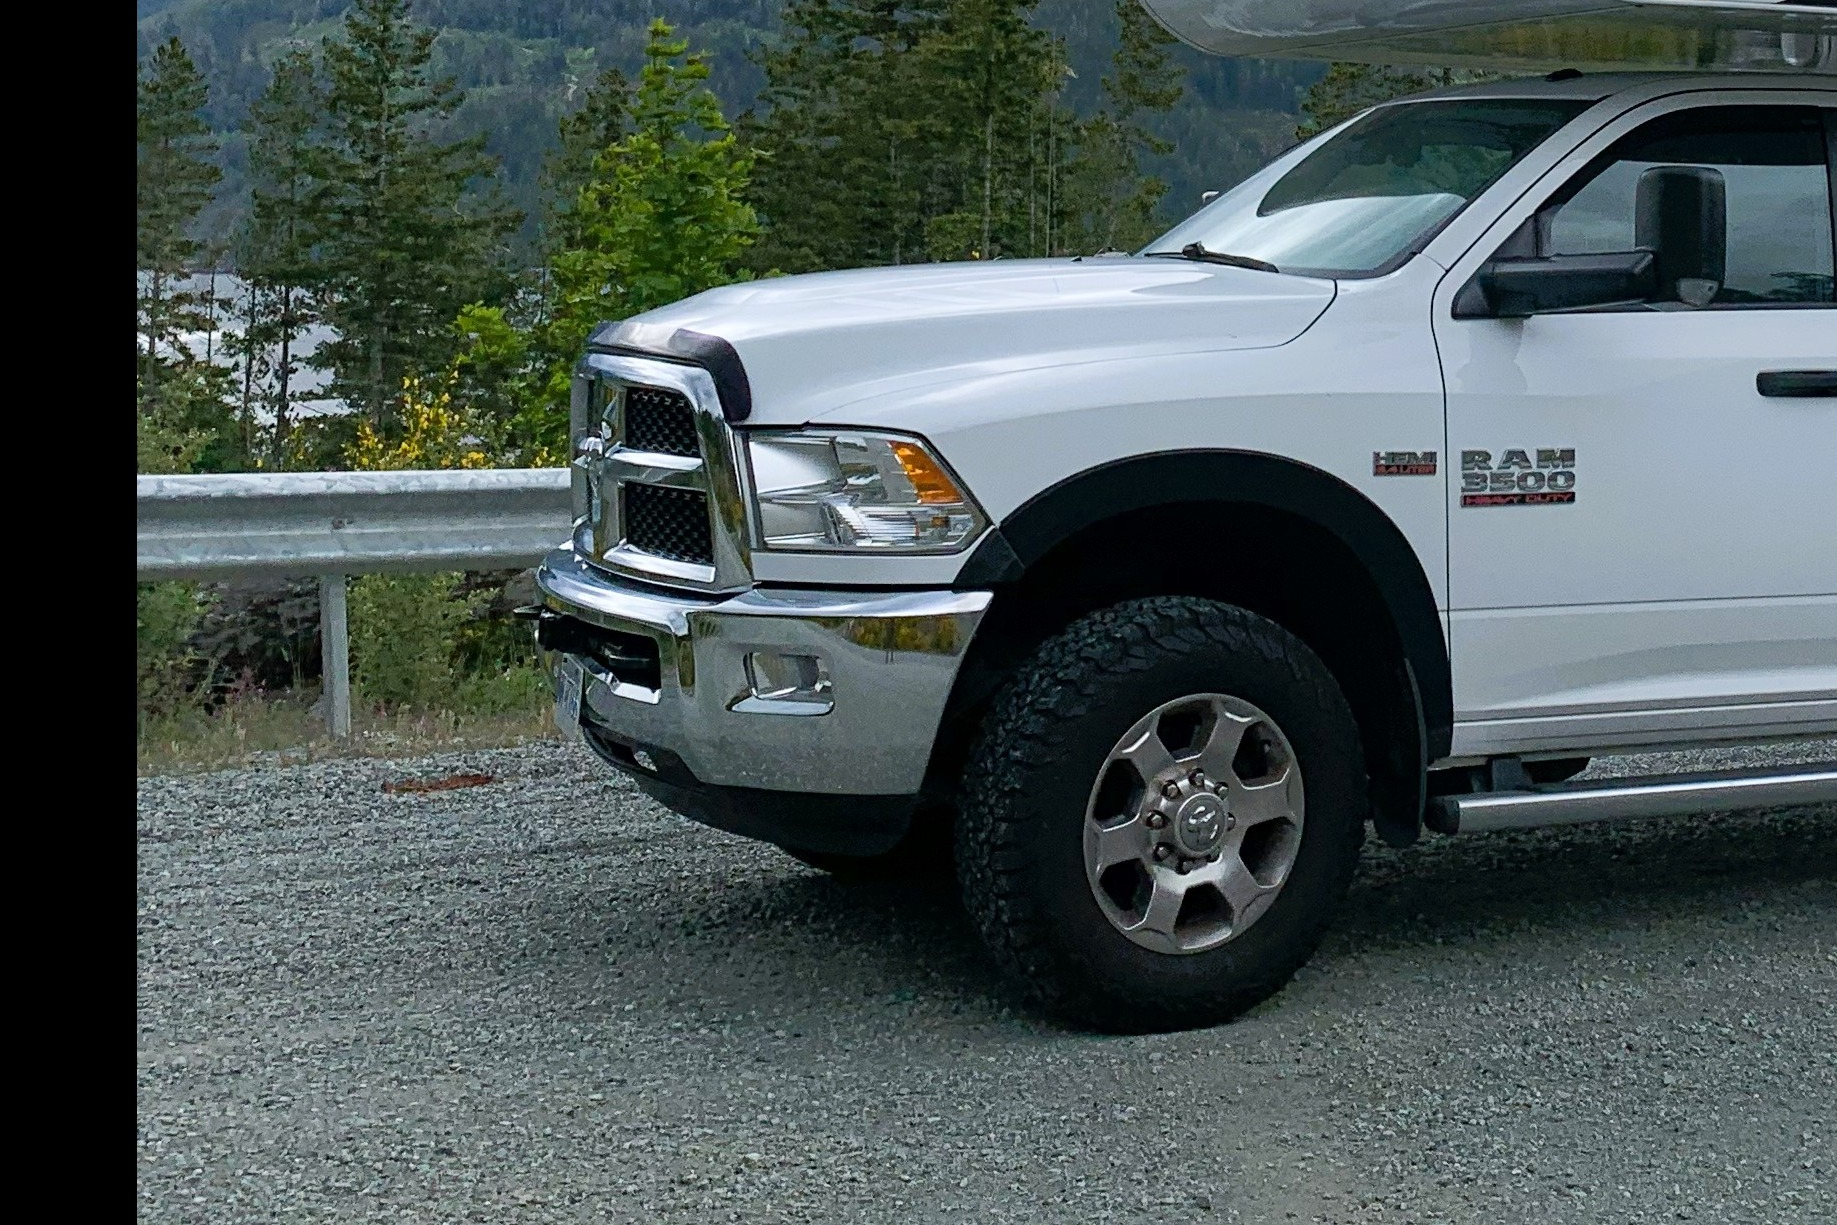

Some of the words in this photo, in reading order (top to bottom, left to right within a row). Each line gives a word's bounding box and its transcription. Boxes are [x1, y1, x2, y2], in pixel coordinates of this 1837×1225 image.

[1373, 451, 1437, 465] HEMI
[1461, 448, 1576, 471] RAM
[1461, 471, 1576, 492] 3500
[1465, 494, 1519, 506] HEAVY
[1524, 492, 1574, 504] DUTY
